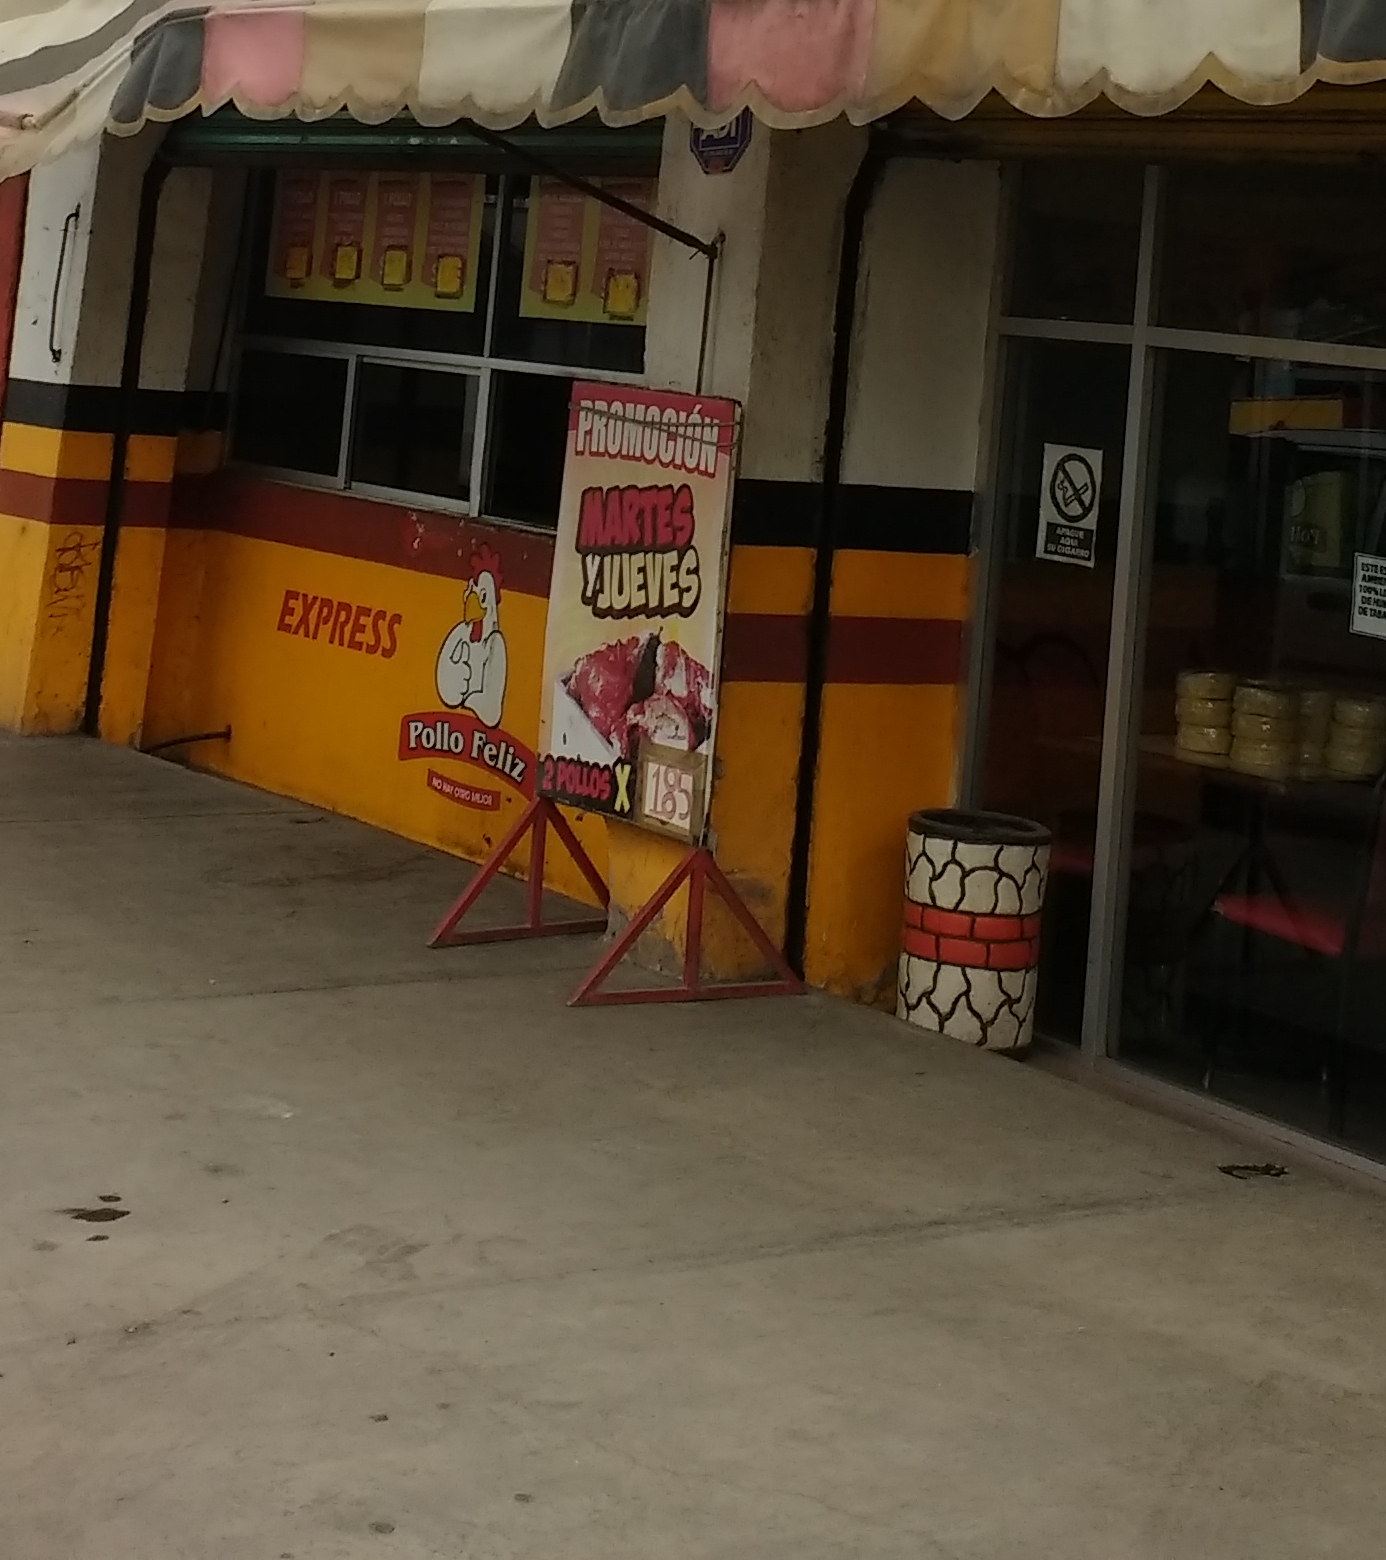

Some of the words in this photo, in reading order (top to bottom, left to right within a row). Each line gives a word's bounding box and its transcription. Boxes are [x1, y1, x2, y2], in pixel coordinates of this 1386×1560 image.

[575, 400, 720, 477] PROMOCIÓN
[577, 485, 694, 551] MARTES
[583, 553, 602, 600] Y
[595, 546, 700, 616] JUEVES
[1359, 585, 1378, 596] 100%
[1361, 562, 1378, 574] ESTE
[277, 589, 403, 659] EXPRESS
[1358, 606, 1368, 616] DE
[1361, 595, 1371, 605] DE
[408, 721, 464, 754] Pollo
[470, 730, 528, 783] Feliz
[432, 777, 442, 790] NO
[542, 757, 554, 790] 2
[556, 760, 611, 800] POLLOS
[614, 761, 632, 814] X
